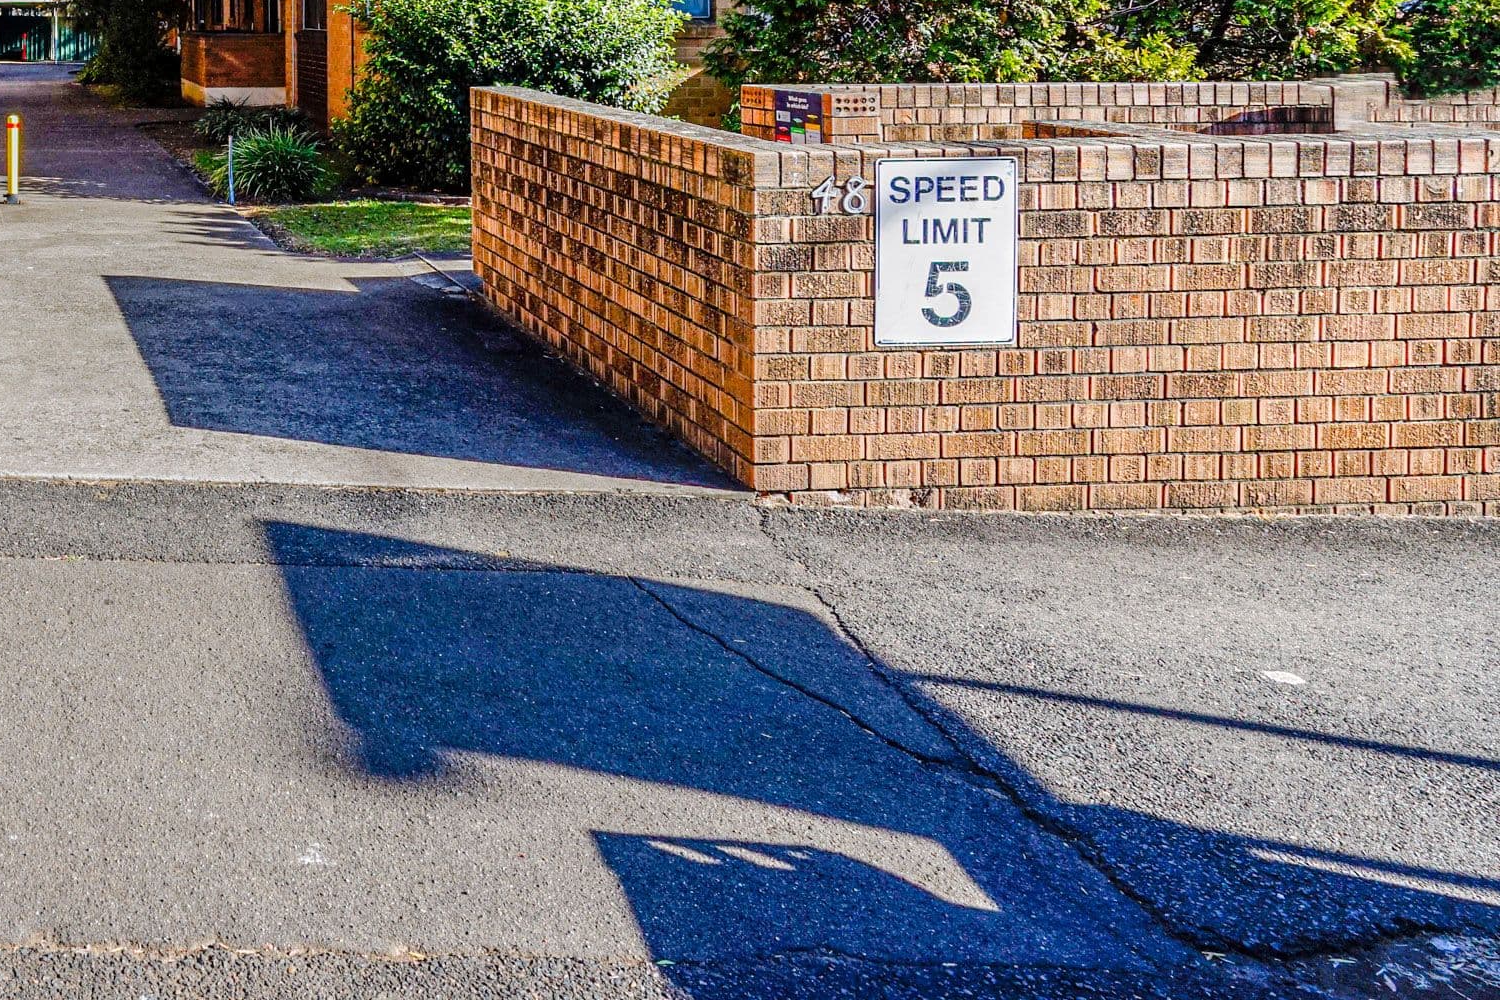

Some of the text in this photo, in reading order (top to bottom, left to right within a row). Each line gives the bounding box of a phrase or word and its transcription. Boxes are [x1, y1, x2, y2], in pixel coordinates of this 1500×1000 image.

[811, 175, 868, 215] 48
[889, 175, 1005, 204] SPEED
[902, 217, 991, 245] LIMIT
[921, 261, 972, 328] 5
